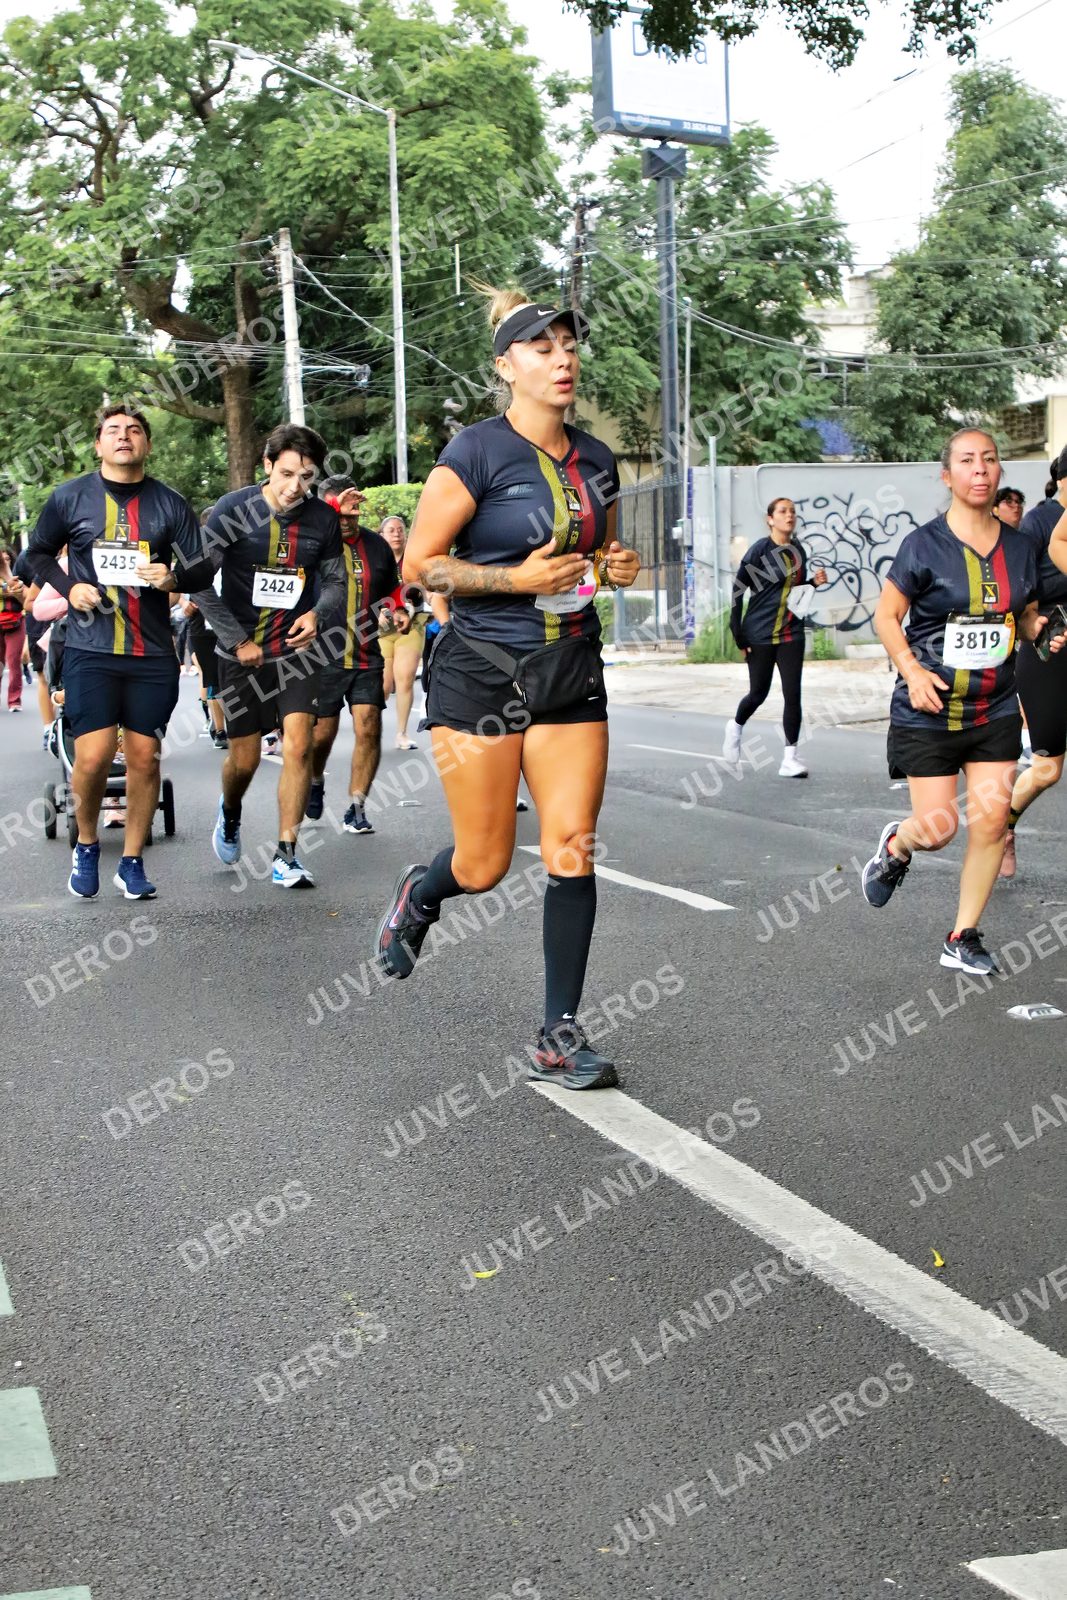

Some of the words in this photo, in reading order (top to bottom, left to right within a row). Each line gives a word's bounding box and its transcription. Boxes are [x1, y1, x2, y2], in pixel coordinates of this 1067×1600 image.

[794, 492, 854, 516] TOY
[100, 554, 137, 570] 2435
[260, 578, 295, 594] 2424
[954, 630, 1001, 650] 3819
